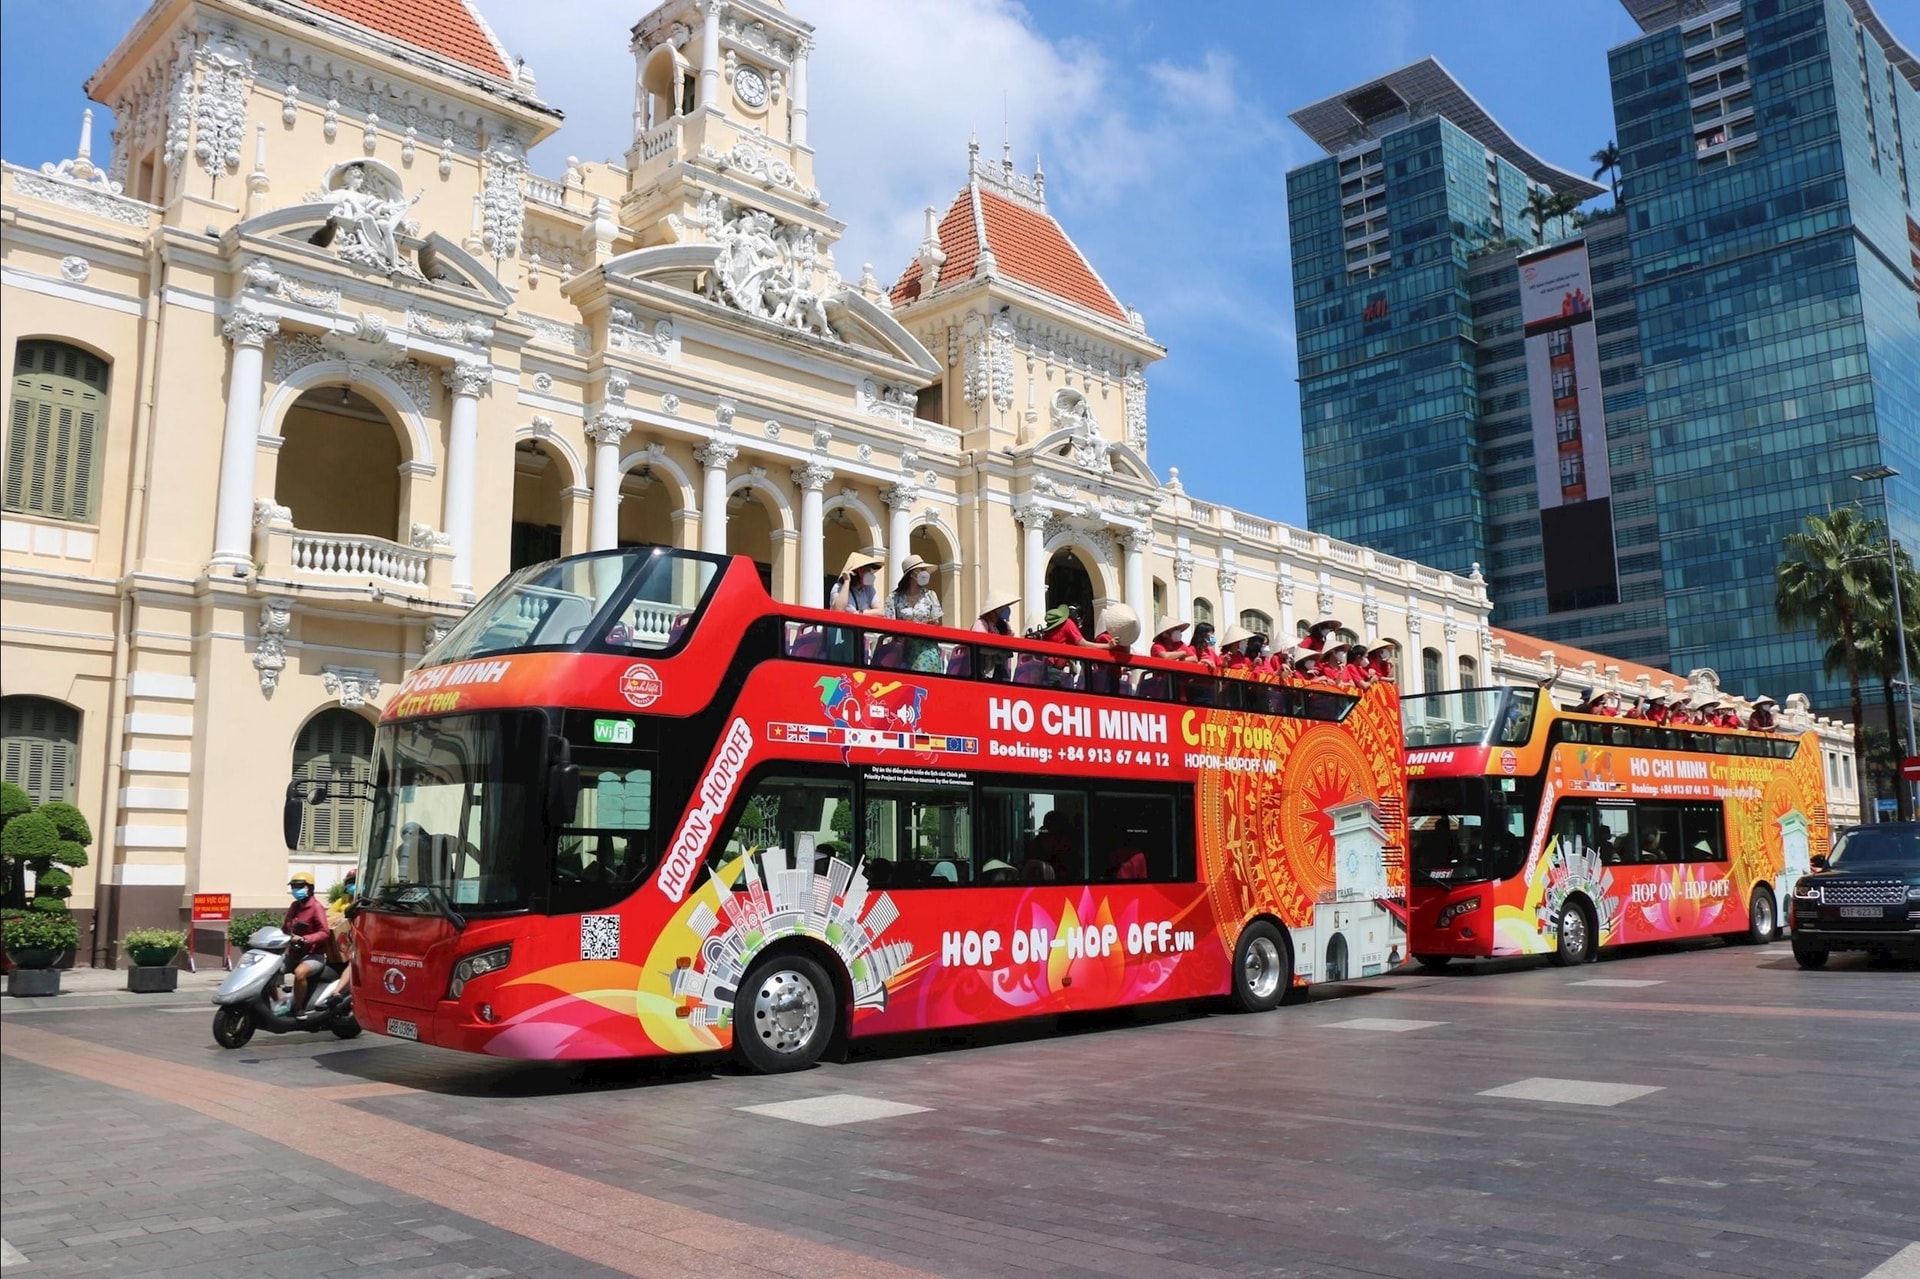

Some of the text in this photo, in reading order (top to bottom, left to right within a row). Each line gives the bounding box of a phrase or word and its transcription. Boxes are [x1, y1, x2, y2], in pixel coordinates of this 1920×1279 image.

[414, 666, 452, 692] CHI
[445, 661, 512, 687] MINH
[397, 691, 460, 717] CITY TOUR
[989, 697, 1274, 751] HO CHI MINH CITY TOUR
[989, 740, 1170, 767] Booking: +84 913 67 44 12
[1184, 754, 1277, 774] HOPON-HOPOFF.VN
[1407, 751, 1455, 764] MINH
[1630, 757, 1650, 777] HO
[1652, 758, 1674, 778] CHI
[1676, 760, 1708, 779] MINH
[1631, 883, 1657, 903] HOP
[1659, 882, 1676, 901] ON
[1684, 881, 1707, 899] HOP
[1709, 879, 1730, 898] OFF
[941, 930, 1001, 968] HOP
